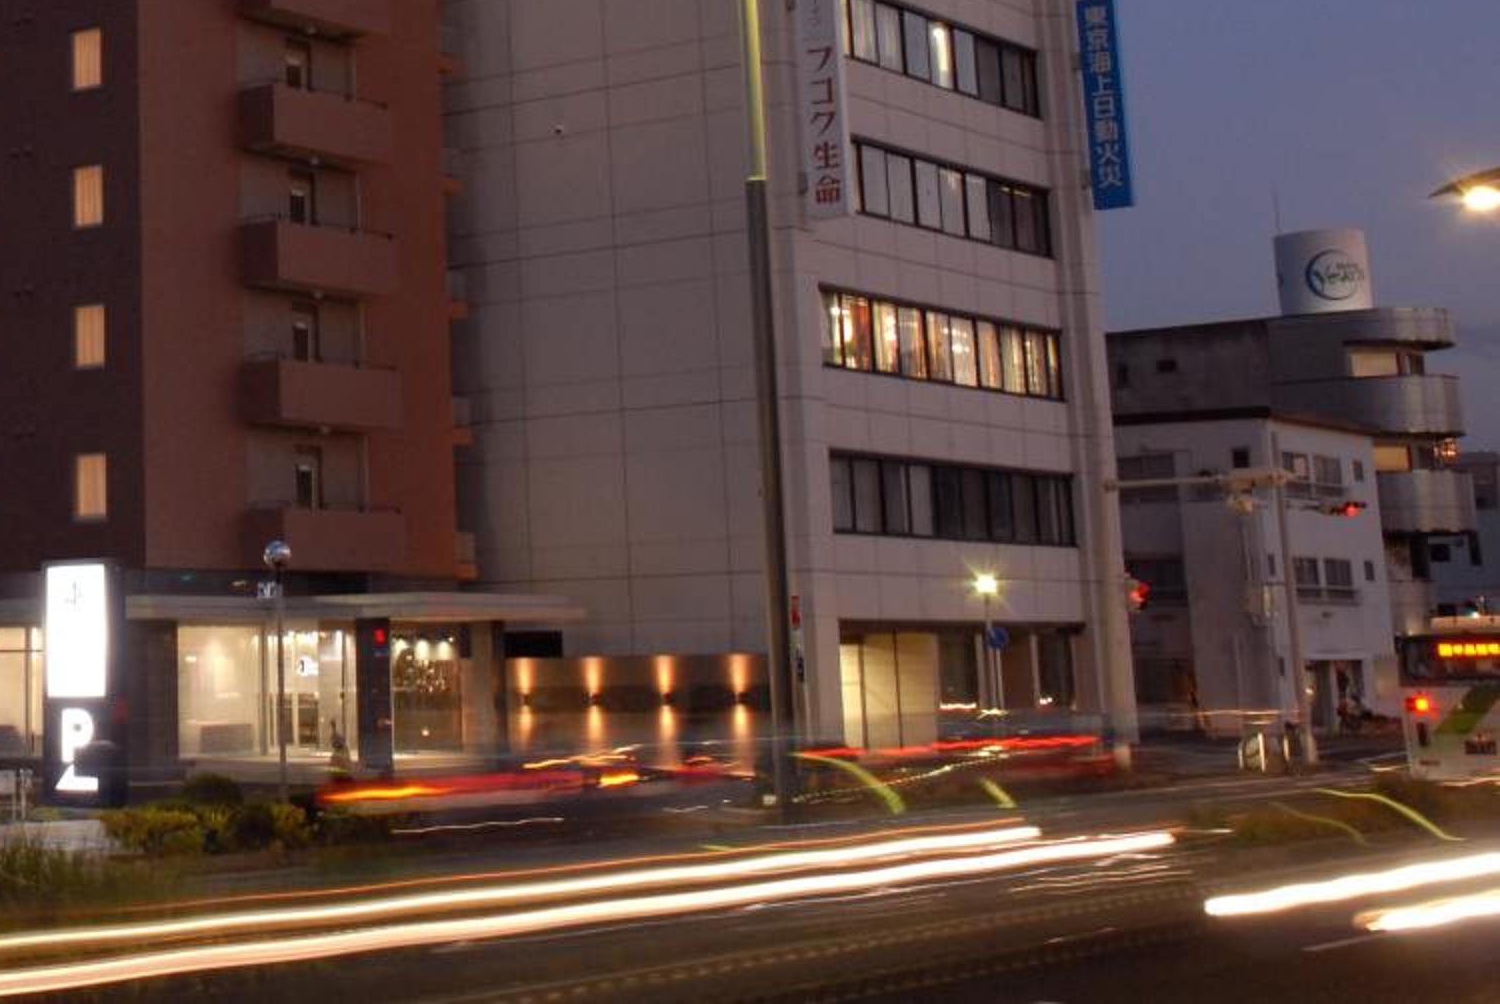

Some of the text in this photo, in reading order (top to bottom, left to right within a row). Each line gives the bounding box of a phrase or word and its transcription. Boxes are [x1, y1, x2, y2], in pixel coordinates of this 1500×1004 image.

[806, 46, 841, 205] フコク生命
[61, 708, 94, 763] P
